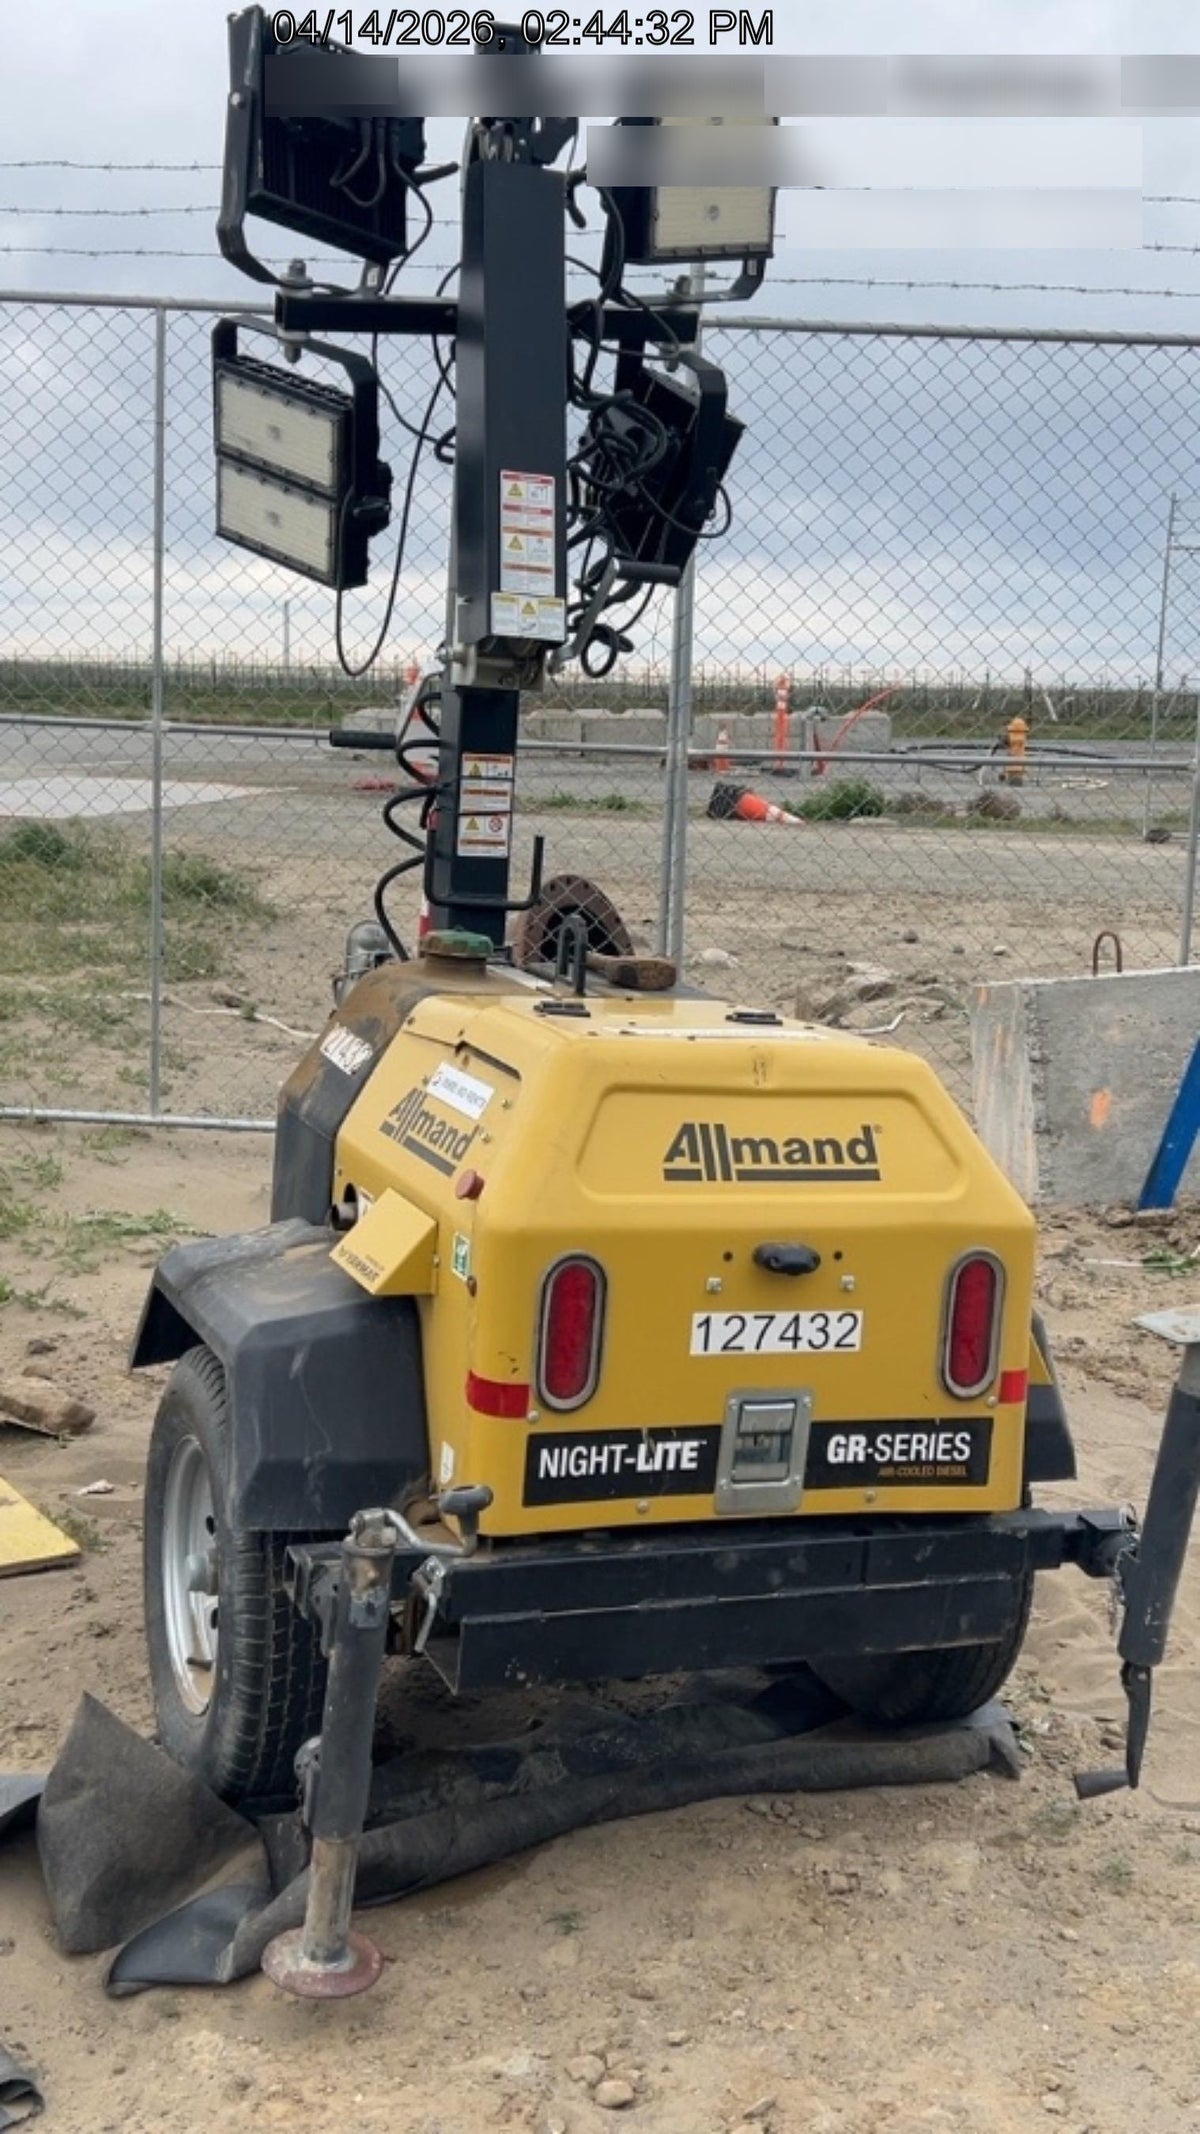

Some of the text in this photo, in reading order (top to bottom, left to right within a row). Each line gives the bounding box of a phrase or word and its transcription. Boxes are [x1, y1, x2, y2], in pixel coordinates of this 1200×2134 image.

[388, 1087, 481, 1162] Allmand
[663, 1122, 879, 1182] Allmand
[696, 1312, 859, 1352] 127432
[827, 1432, 972, 1464] GR-SERIES
